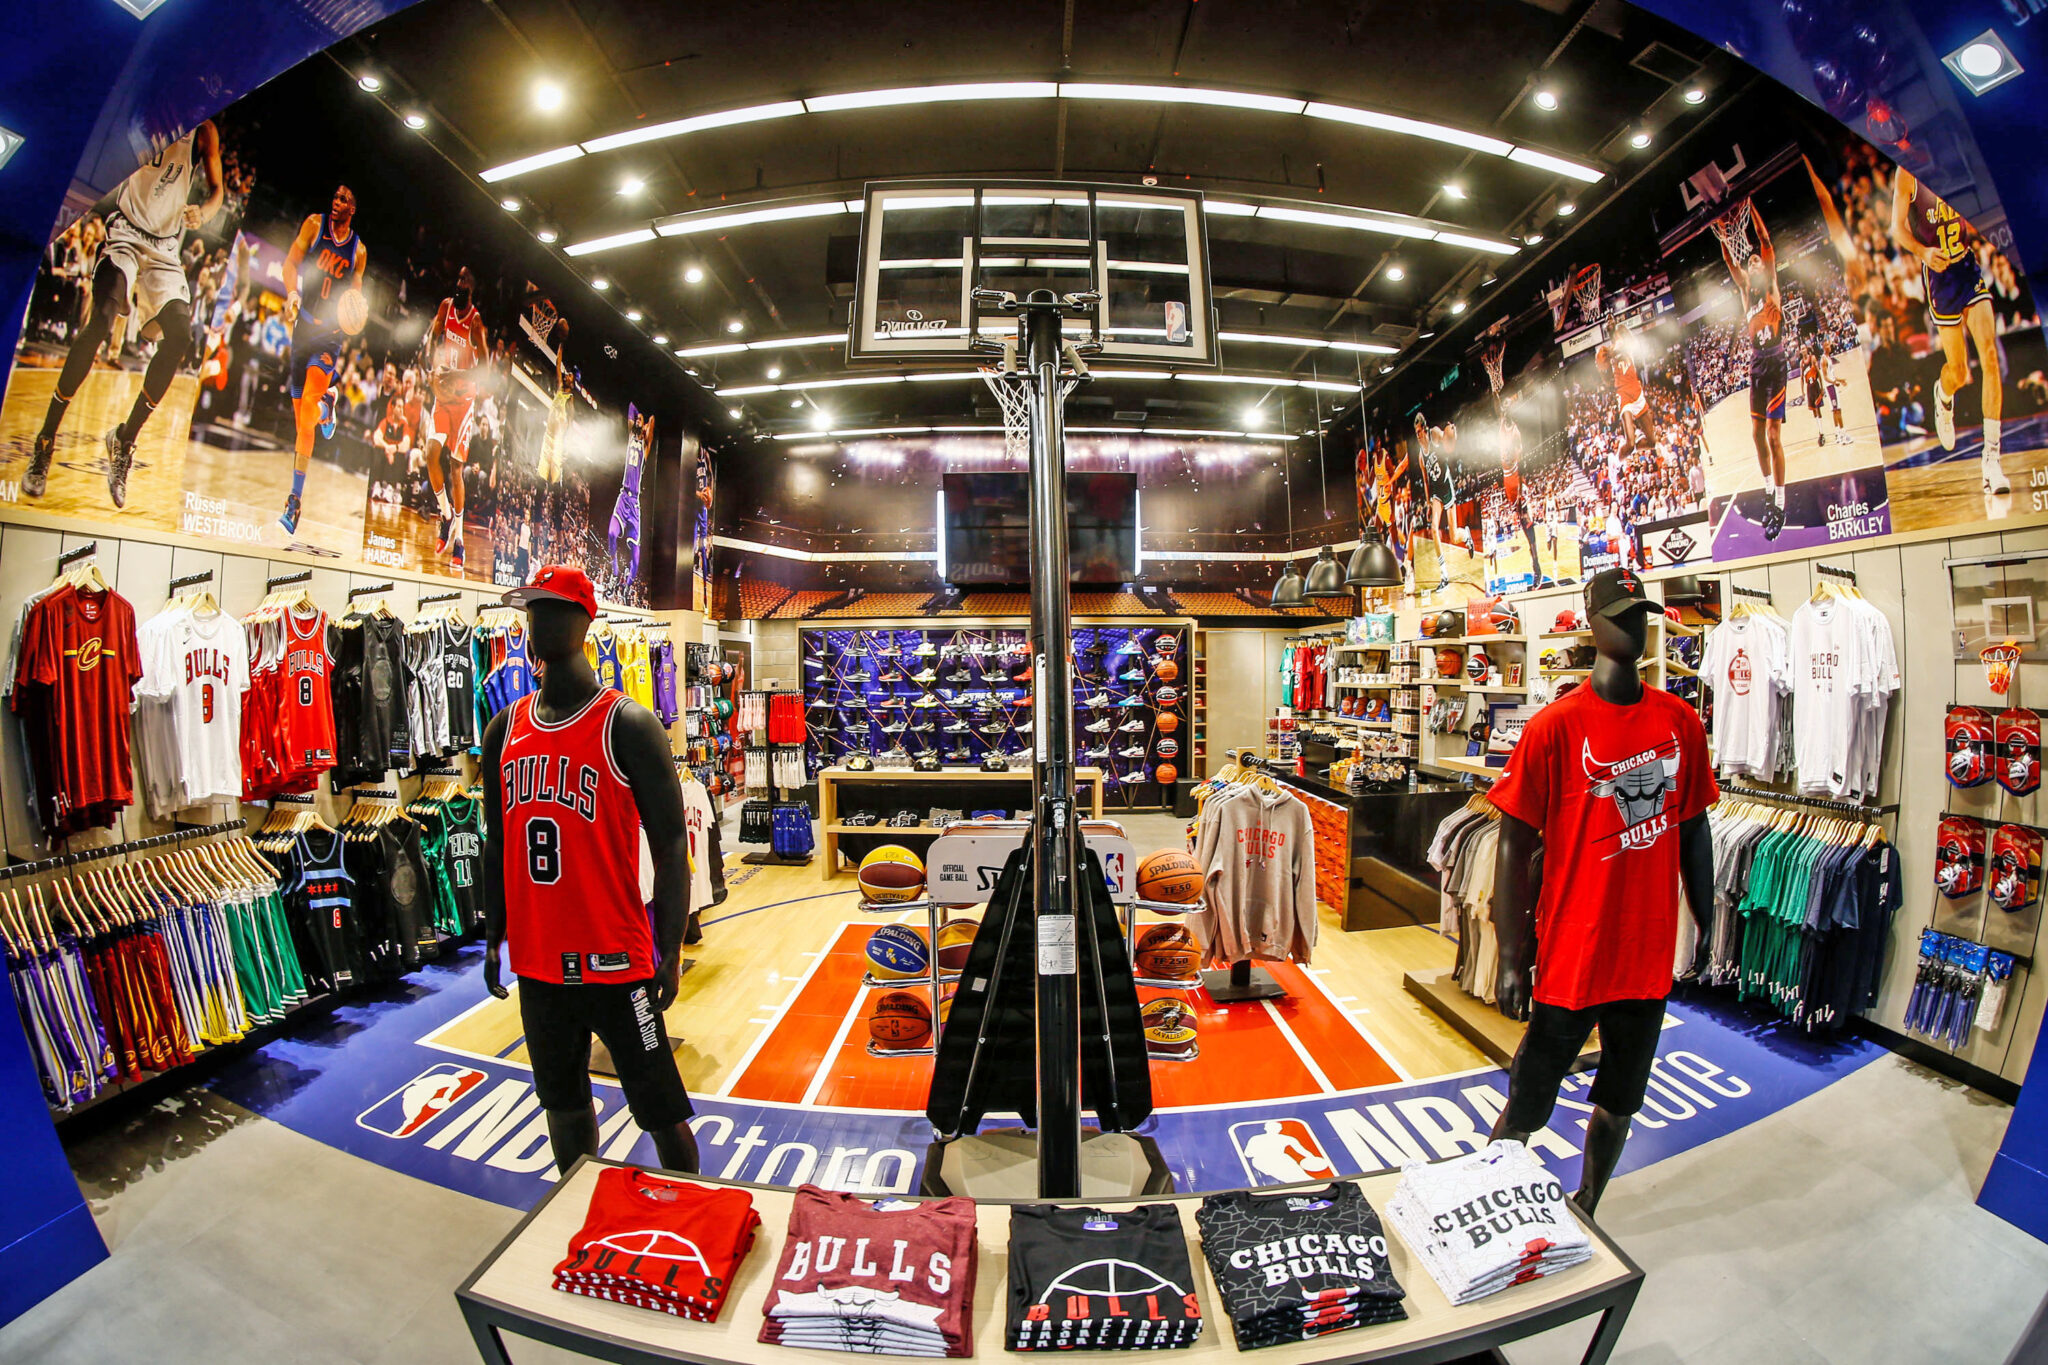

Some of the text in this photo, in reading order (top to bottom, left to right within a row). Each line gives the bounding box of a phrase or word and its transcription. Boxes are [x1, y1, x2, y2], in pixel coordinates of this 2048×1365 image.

[1936, 222, 1965, 256] 12
[316, 248, 350, 279] OKC
[1757, 325, 1772, 345] 34
[185, 491, 226, 516] Russel
[1827, 500, 1869, 521] Charles
[183, 513, 262, 542] WESTBROOK
[367, 531, 396, 549] James
[1670, 532, 1684, 541] BLUE
[1829, 515, 1884, 540] BARKLEY
[366, 547, 406, 568] HARDEN
[1666, 539, 1689, 549] DIAMOND
[494, 571, 522, 588] DURANT
[185, 648, 231, 687] BULLS
[288, 650, 323, 677] BULLS
[299, 677, 313, 706] 8
[447, 671, 464, 688] 20
[202, 683, 214, 724] 8
[1611, 749, 1657, 776] CHICAGO
[502, 755, 599, 823] BULLS
[1619, 814, 1668, 850] BULLS
[526, 816, 561, 885] 8
[1246, 841, 1276, 859] ULLS
[940, 873, 954, 881] GAME
[942, 864, 965, 873] OFFICIAL
[1149, 859, 1194, 878] SPALDING
[877, 927, 921, 951] SPALDING
[875, 998, 919, 1015] SPALDING
[633, 997, 659, 1051] NBA Store
[1152, 1028, 1188, 1040] CAVALIERS
[1433, 1181, 1563, 1233] CHICAGO
[1466, 1206, 1556, 1249] BULLS
[782, 1235, 951, 1293] BULLS
[1230, 1233, 1389, 1270] CHICAGO
[565, 1249, 722, 1299] BULLS
[1265, 1255, 1375, 1287] BULLS
[1026, 1293, 1201, 1321] BULLS
